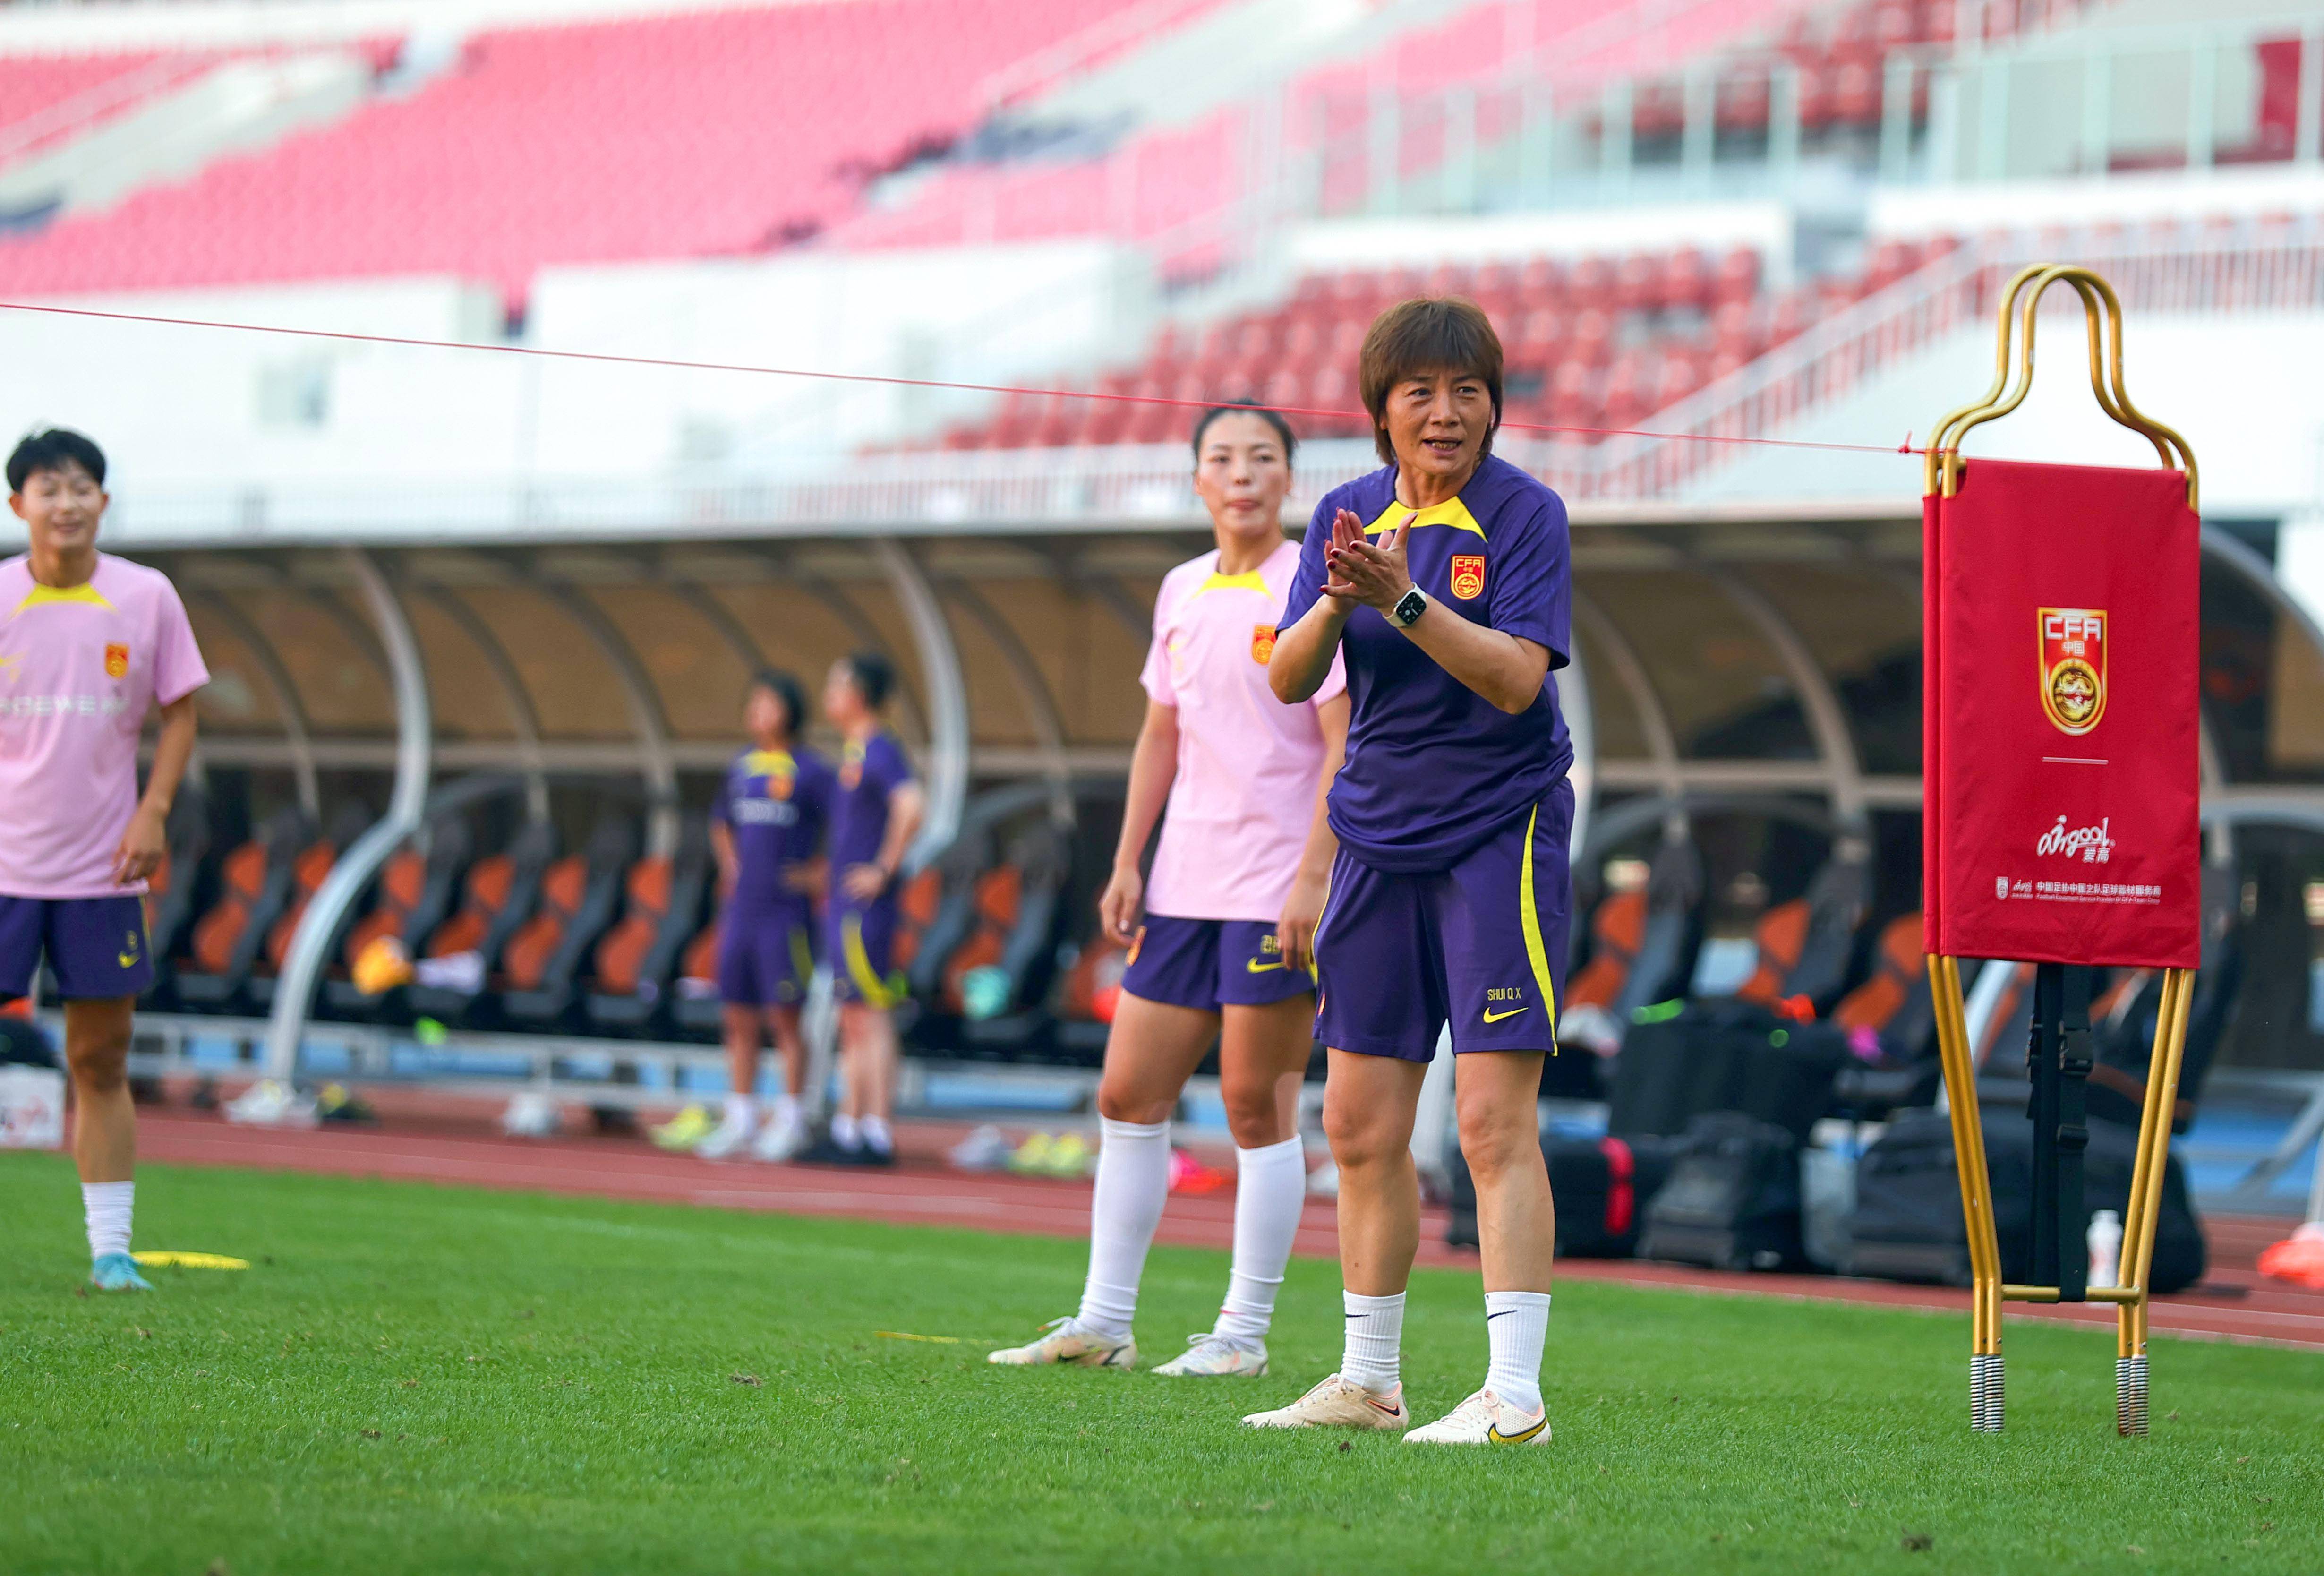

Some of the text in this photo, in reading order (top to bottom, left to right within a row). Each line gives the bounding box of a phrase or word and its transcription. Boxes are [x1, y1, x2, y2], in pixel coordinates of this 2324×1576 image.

[1456, 559, 1481, 567] CFA
[2045, 616, 2102, 642] CFA
[2062, 640, 2085, 656] 中国
[1487, 987, 1521, 1001] SHUI Q X
